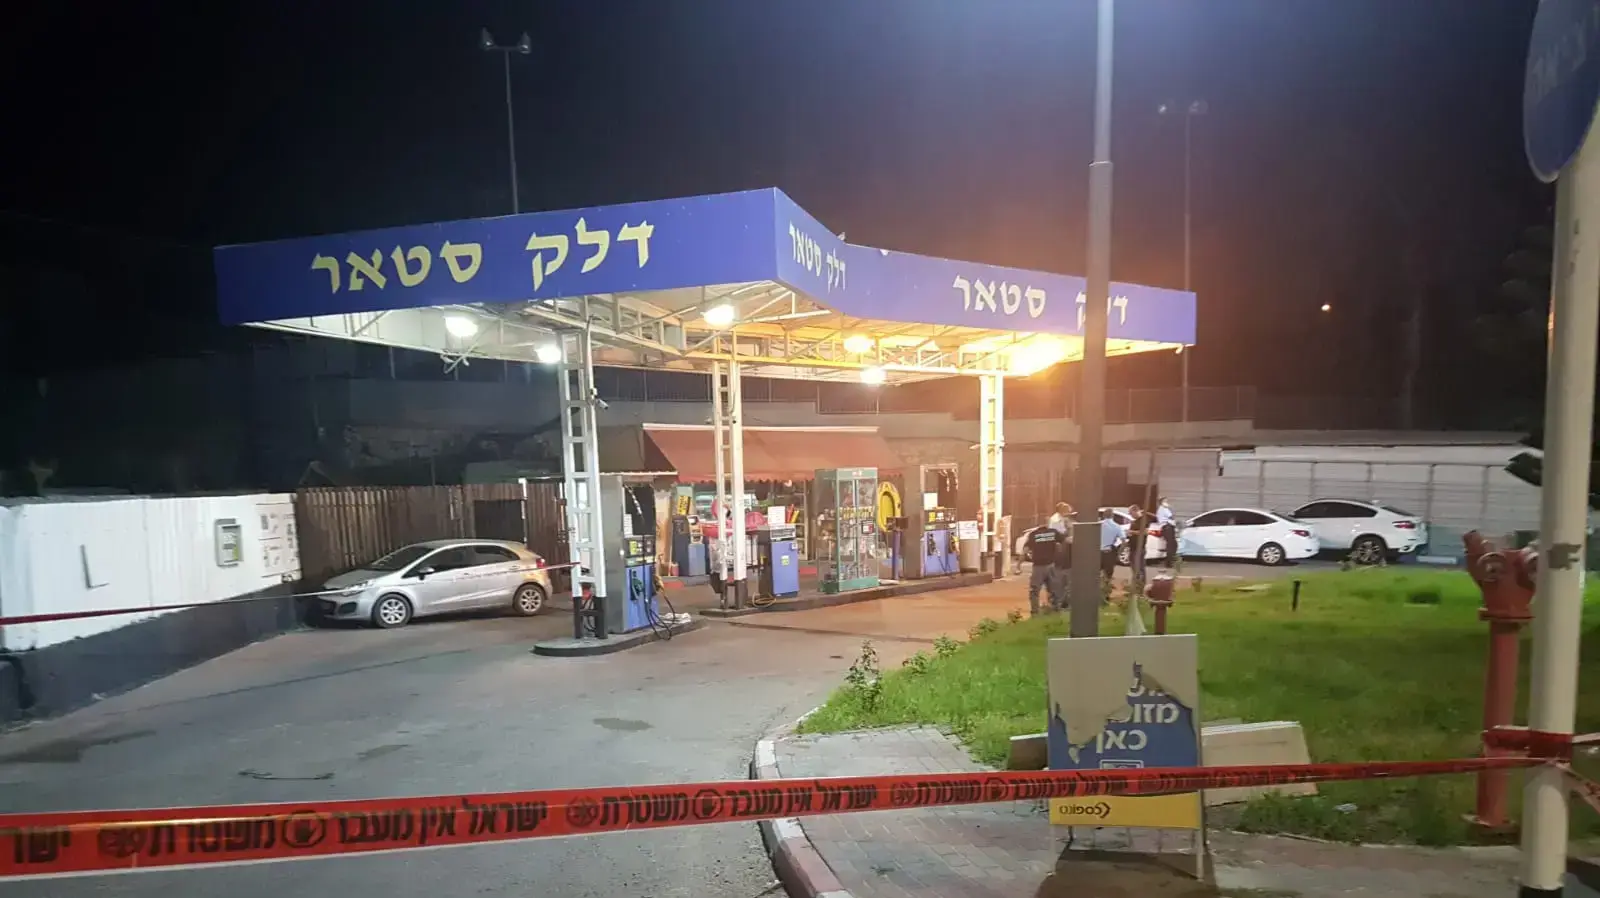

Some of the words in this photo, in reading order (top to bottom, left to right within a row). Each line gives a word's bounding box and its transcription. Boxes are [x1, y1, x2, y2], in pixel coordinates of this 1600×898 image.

[311, 239, 482, 294] סטאר
[525, 217, 654, 291] דלק
[789, 220, 822, 277] סטאר
[826, 248, 846, 294] דלק
[953, 275, 1046, 319] סטאר
[1075, 291, 1128, 331] דק
[1096, 729, 1148, 754] כאן
[461, 796, 547, 835] ישראל
[600, 791, 688, 826] משטרת
[724, 788, 783, 816] מעבר
[332, 811, 413, 845] מעבר
[420, 805, 457, 845] אין
